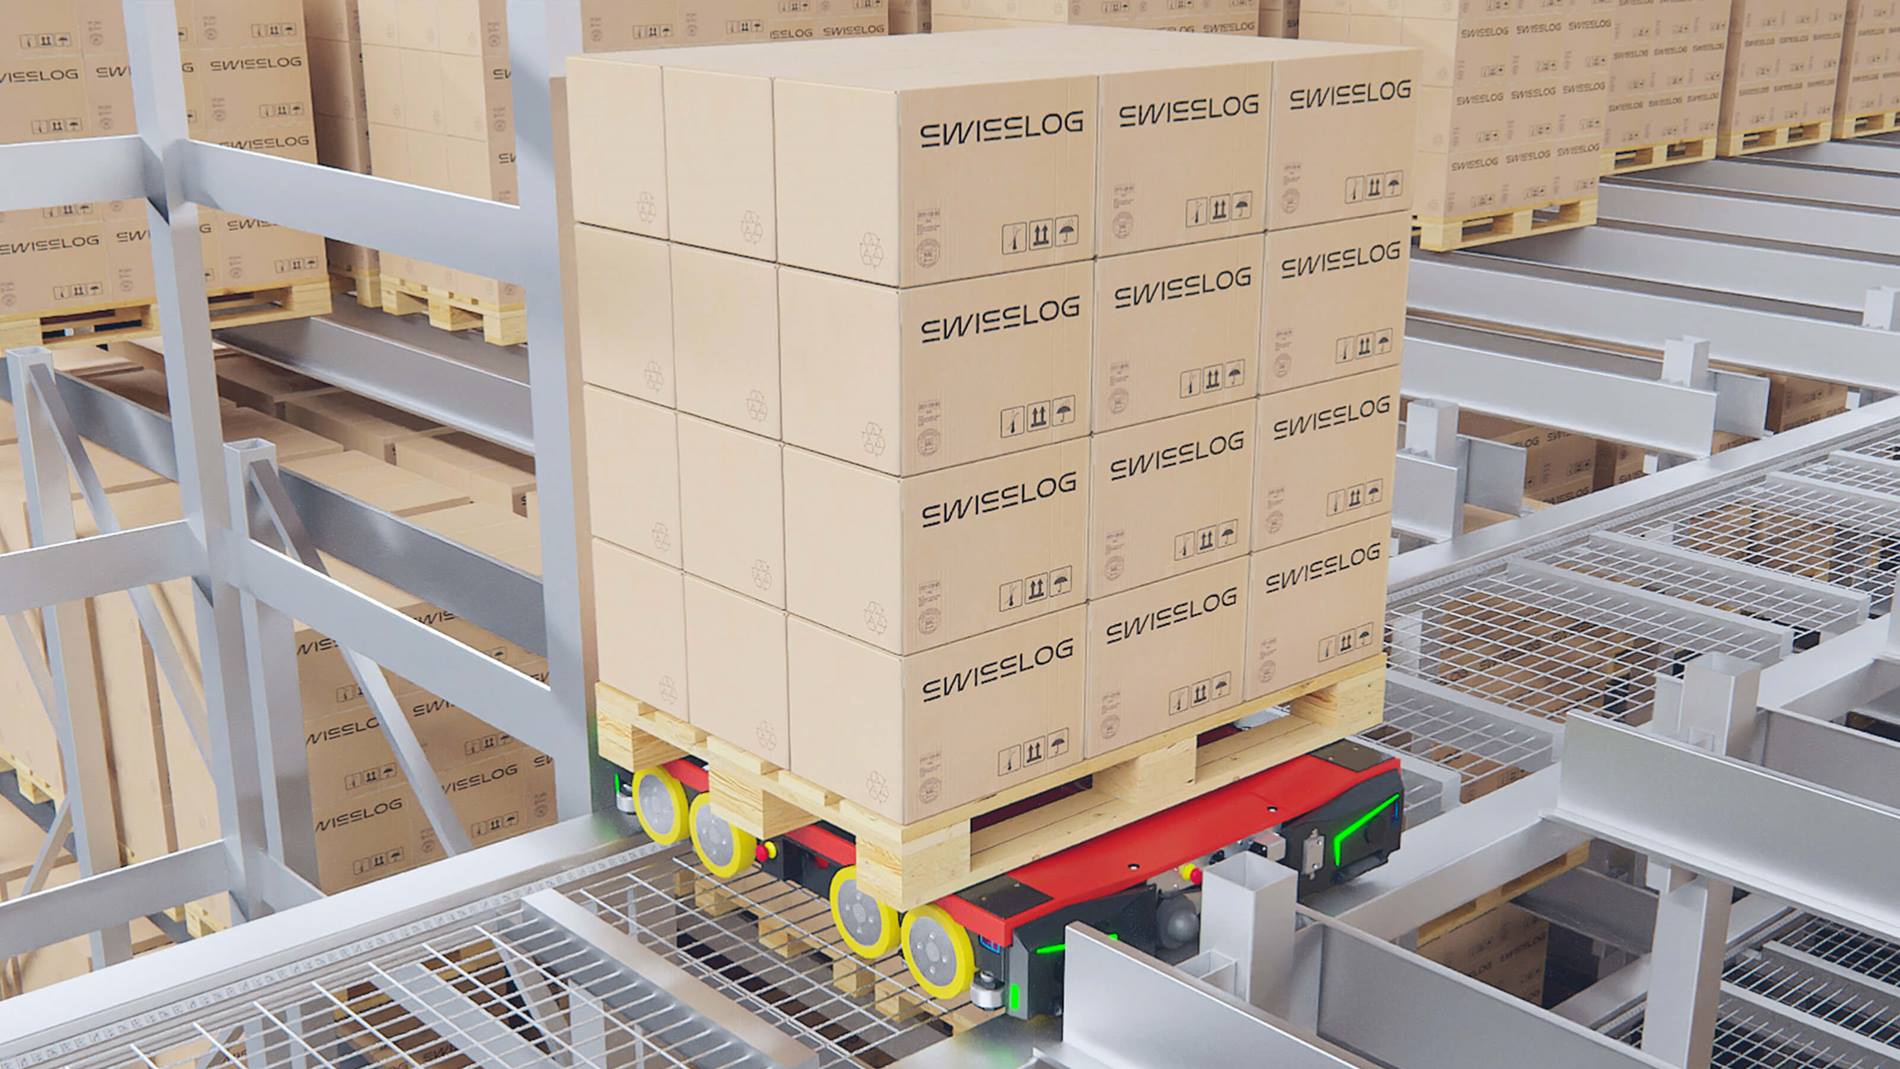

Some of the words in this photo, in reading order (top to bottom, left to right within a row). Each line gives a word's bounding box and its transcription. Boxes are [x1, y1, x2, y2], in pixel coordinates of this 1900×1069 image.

[211, 57, 301, 71] SWISSLOG
[1120, 94, 1258, 127] SWISSLOG
[1290, 80, 1411, 109] SWISSLOG
[920, 110, 1084, 148] SWISSLOG
[1282, 241, 1400, 278] SWISSLOG
[1115, 267, 1251, 308] SWISSLOG
[922, 296, 1079, 343] SWISSLOG
[1274, 396, 1390, 440] SWISSLOG
[1110, 431, 1244, 481] SWISSLOG
[921, 471, 1077, 528] SWISSLOG
[1266, 543, 1380, 593] SWISSLOG
[1106, 587, 1238, 645] SWISSLOG
[922, 638, 1074, 703] SWISSLOG
